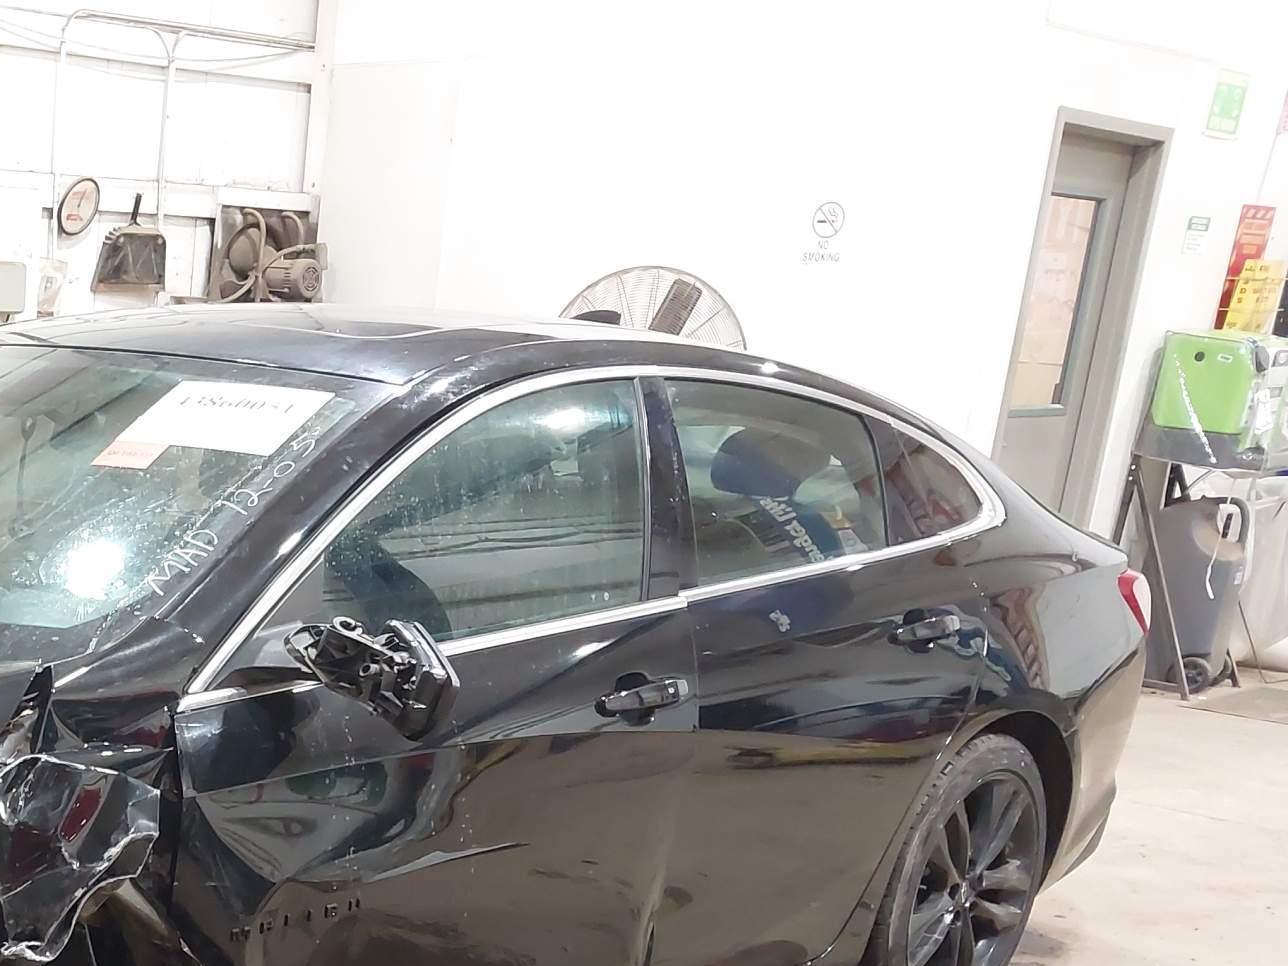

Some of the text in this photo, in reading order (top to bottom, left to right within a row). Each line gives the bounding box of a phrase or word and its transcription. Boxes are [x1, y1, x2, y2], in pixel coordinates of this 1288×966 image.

[817, 240, 829, 250] NO
[801, 251, 840, 263] SMOKING
[147, 529, 219, 596] MAD
